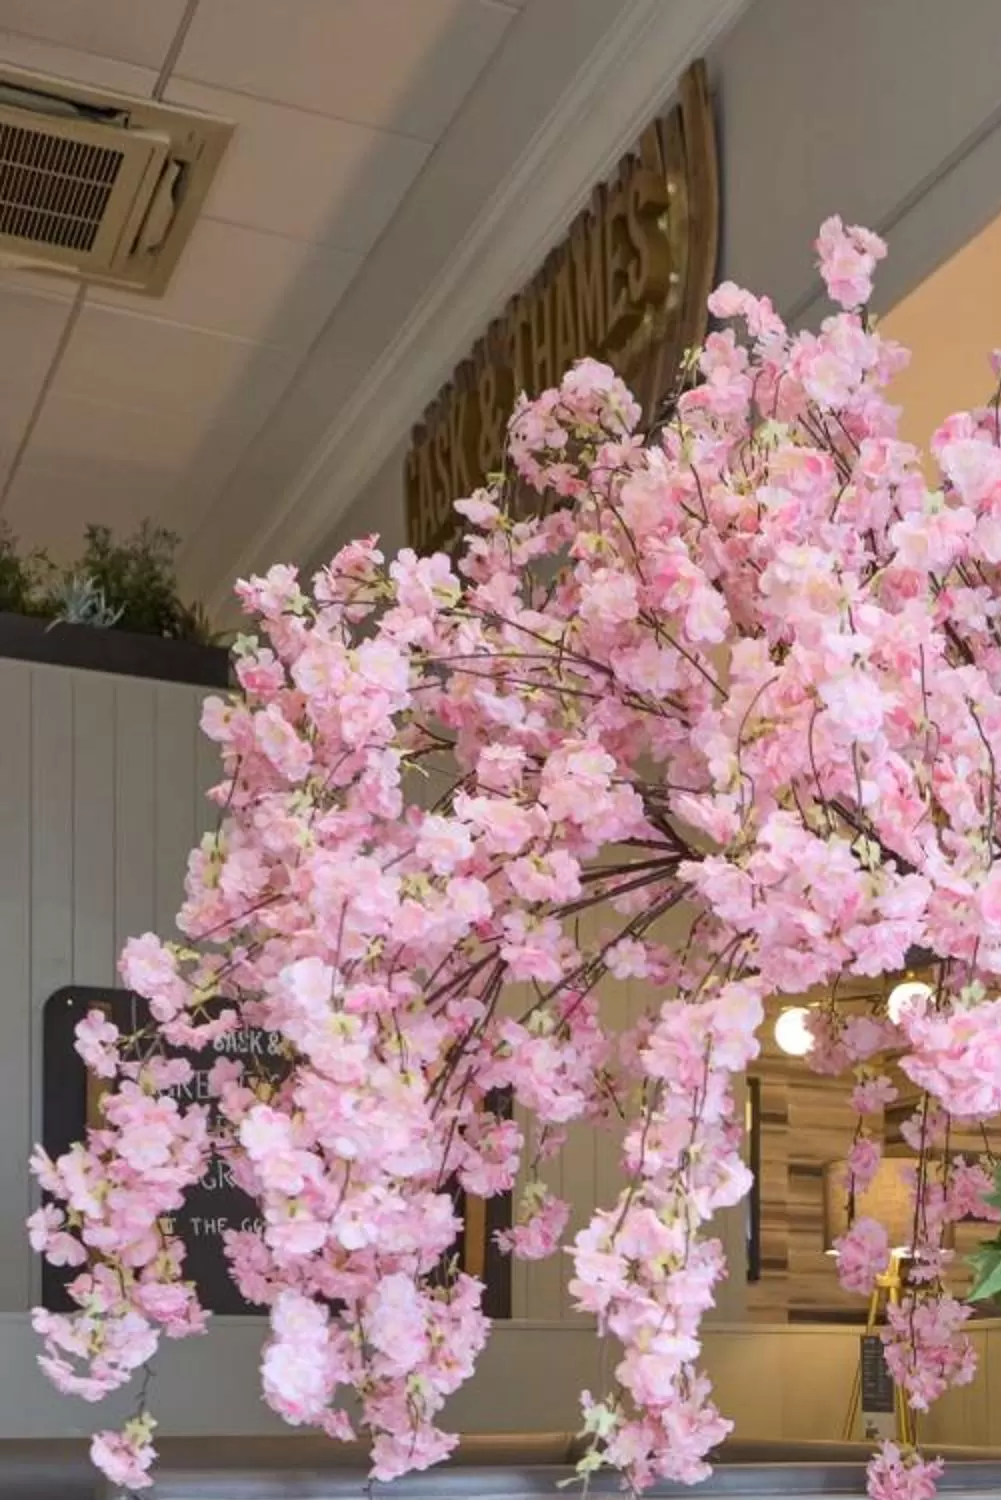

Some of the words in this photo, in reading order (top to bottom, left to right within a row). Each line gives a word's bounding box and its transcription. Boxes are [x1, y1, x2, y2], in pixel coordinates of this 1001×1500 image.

[405, 388, 471, 548] CASK
[479, 364, 505, 476] &
[508, 170, 668, 396] THAMES
[190, 1217, 228, 1237] THE
